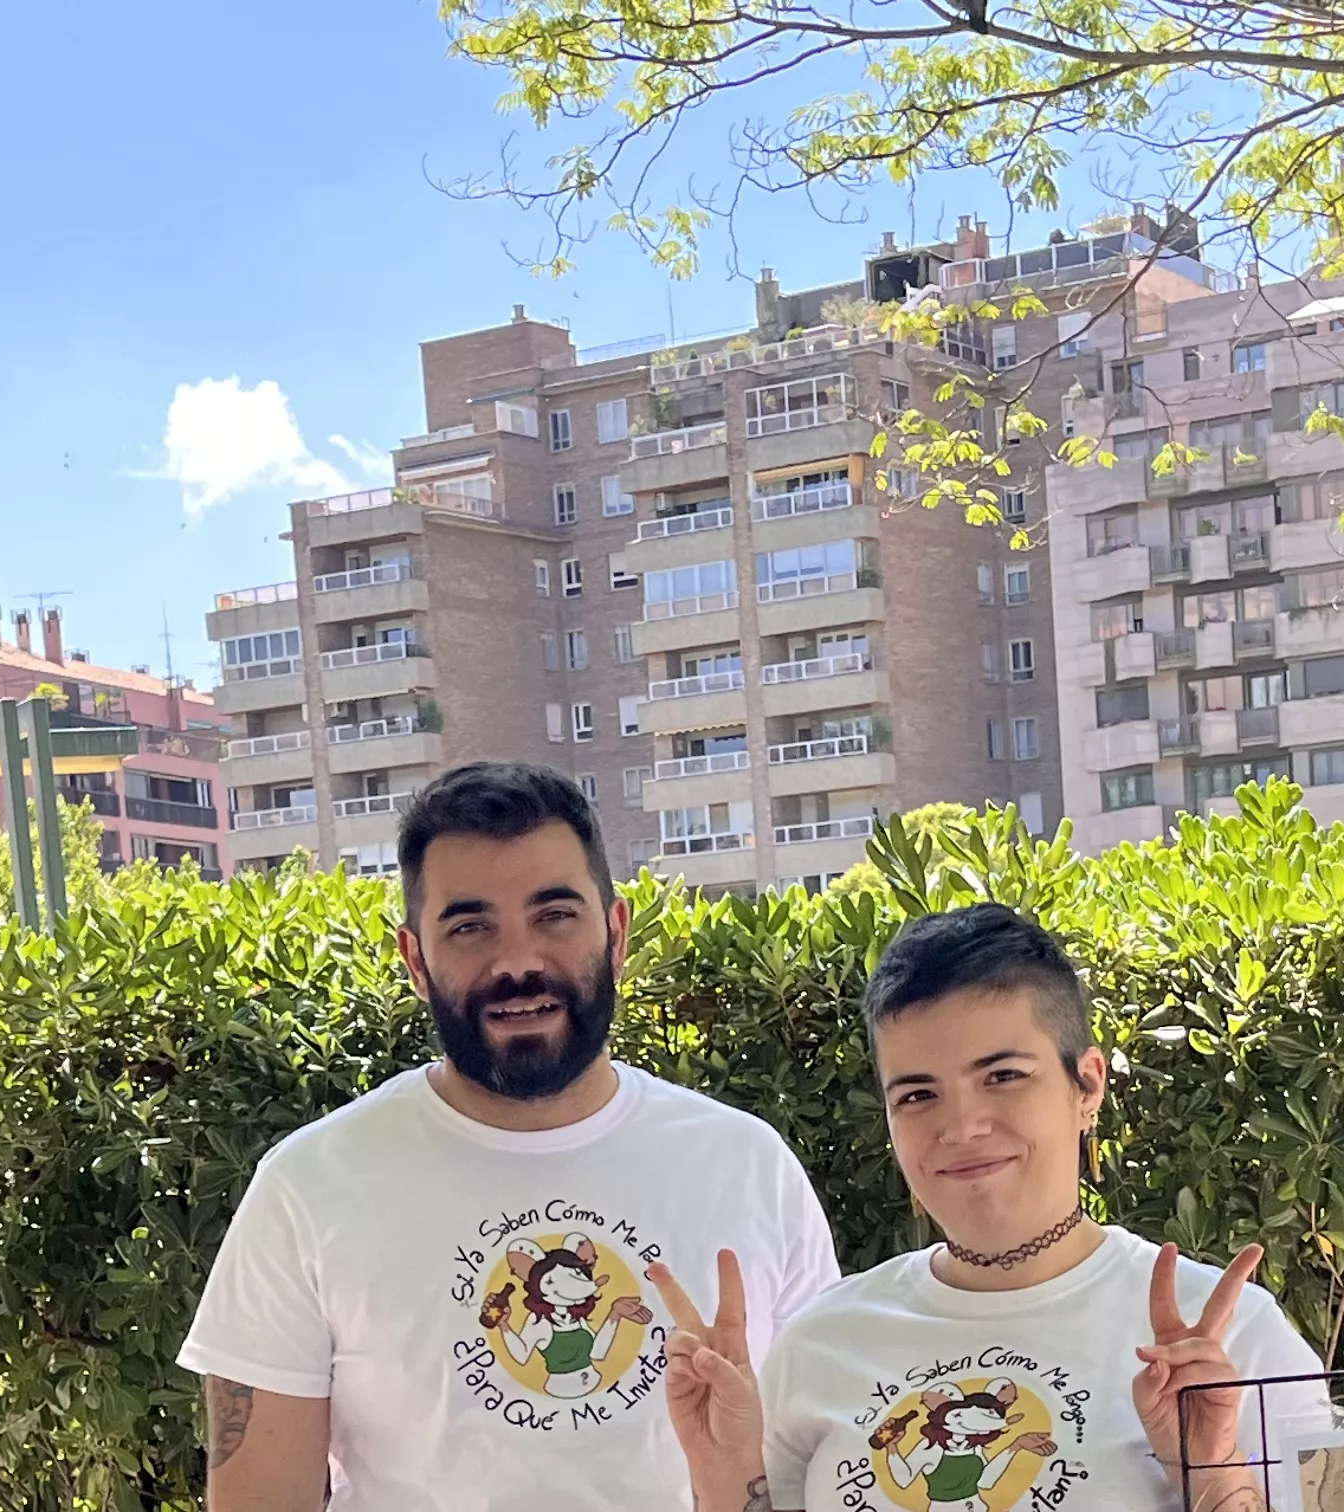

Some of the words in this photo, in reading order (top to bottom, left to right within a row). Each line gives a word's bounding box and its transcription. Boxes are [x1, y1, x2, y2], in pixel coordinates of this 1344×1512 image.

[454, 1245, 485, 1273] Ya
[478, 1208, 540, 1248] Saben
[545, 1199, 605, 1227] Cómo
[611, 1219, 639, 1248] Me
[871, 1381, 900, 1405] Ya
[905, 1356, 972, 1388] Saben
[978, 1346, 1038, 1370] Cómo
[1040, 1367, 1070, 1391] Me
[503, 1399, 560, 1431] Qué
[571, 1402, 613, 1431] Me
